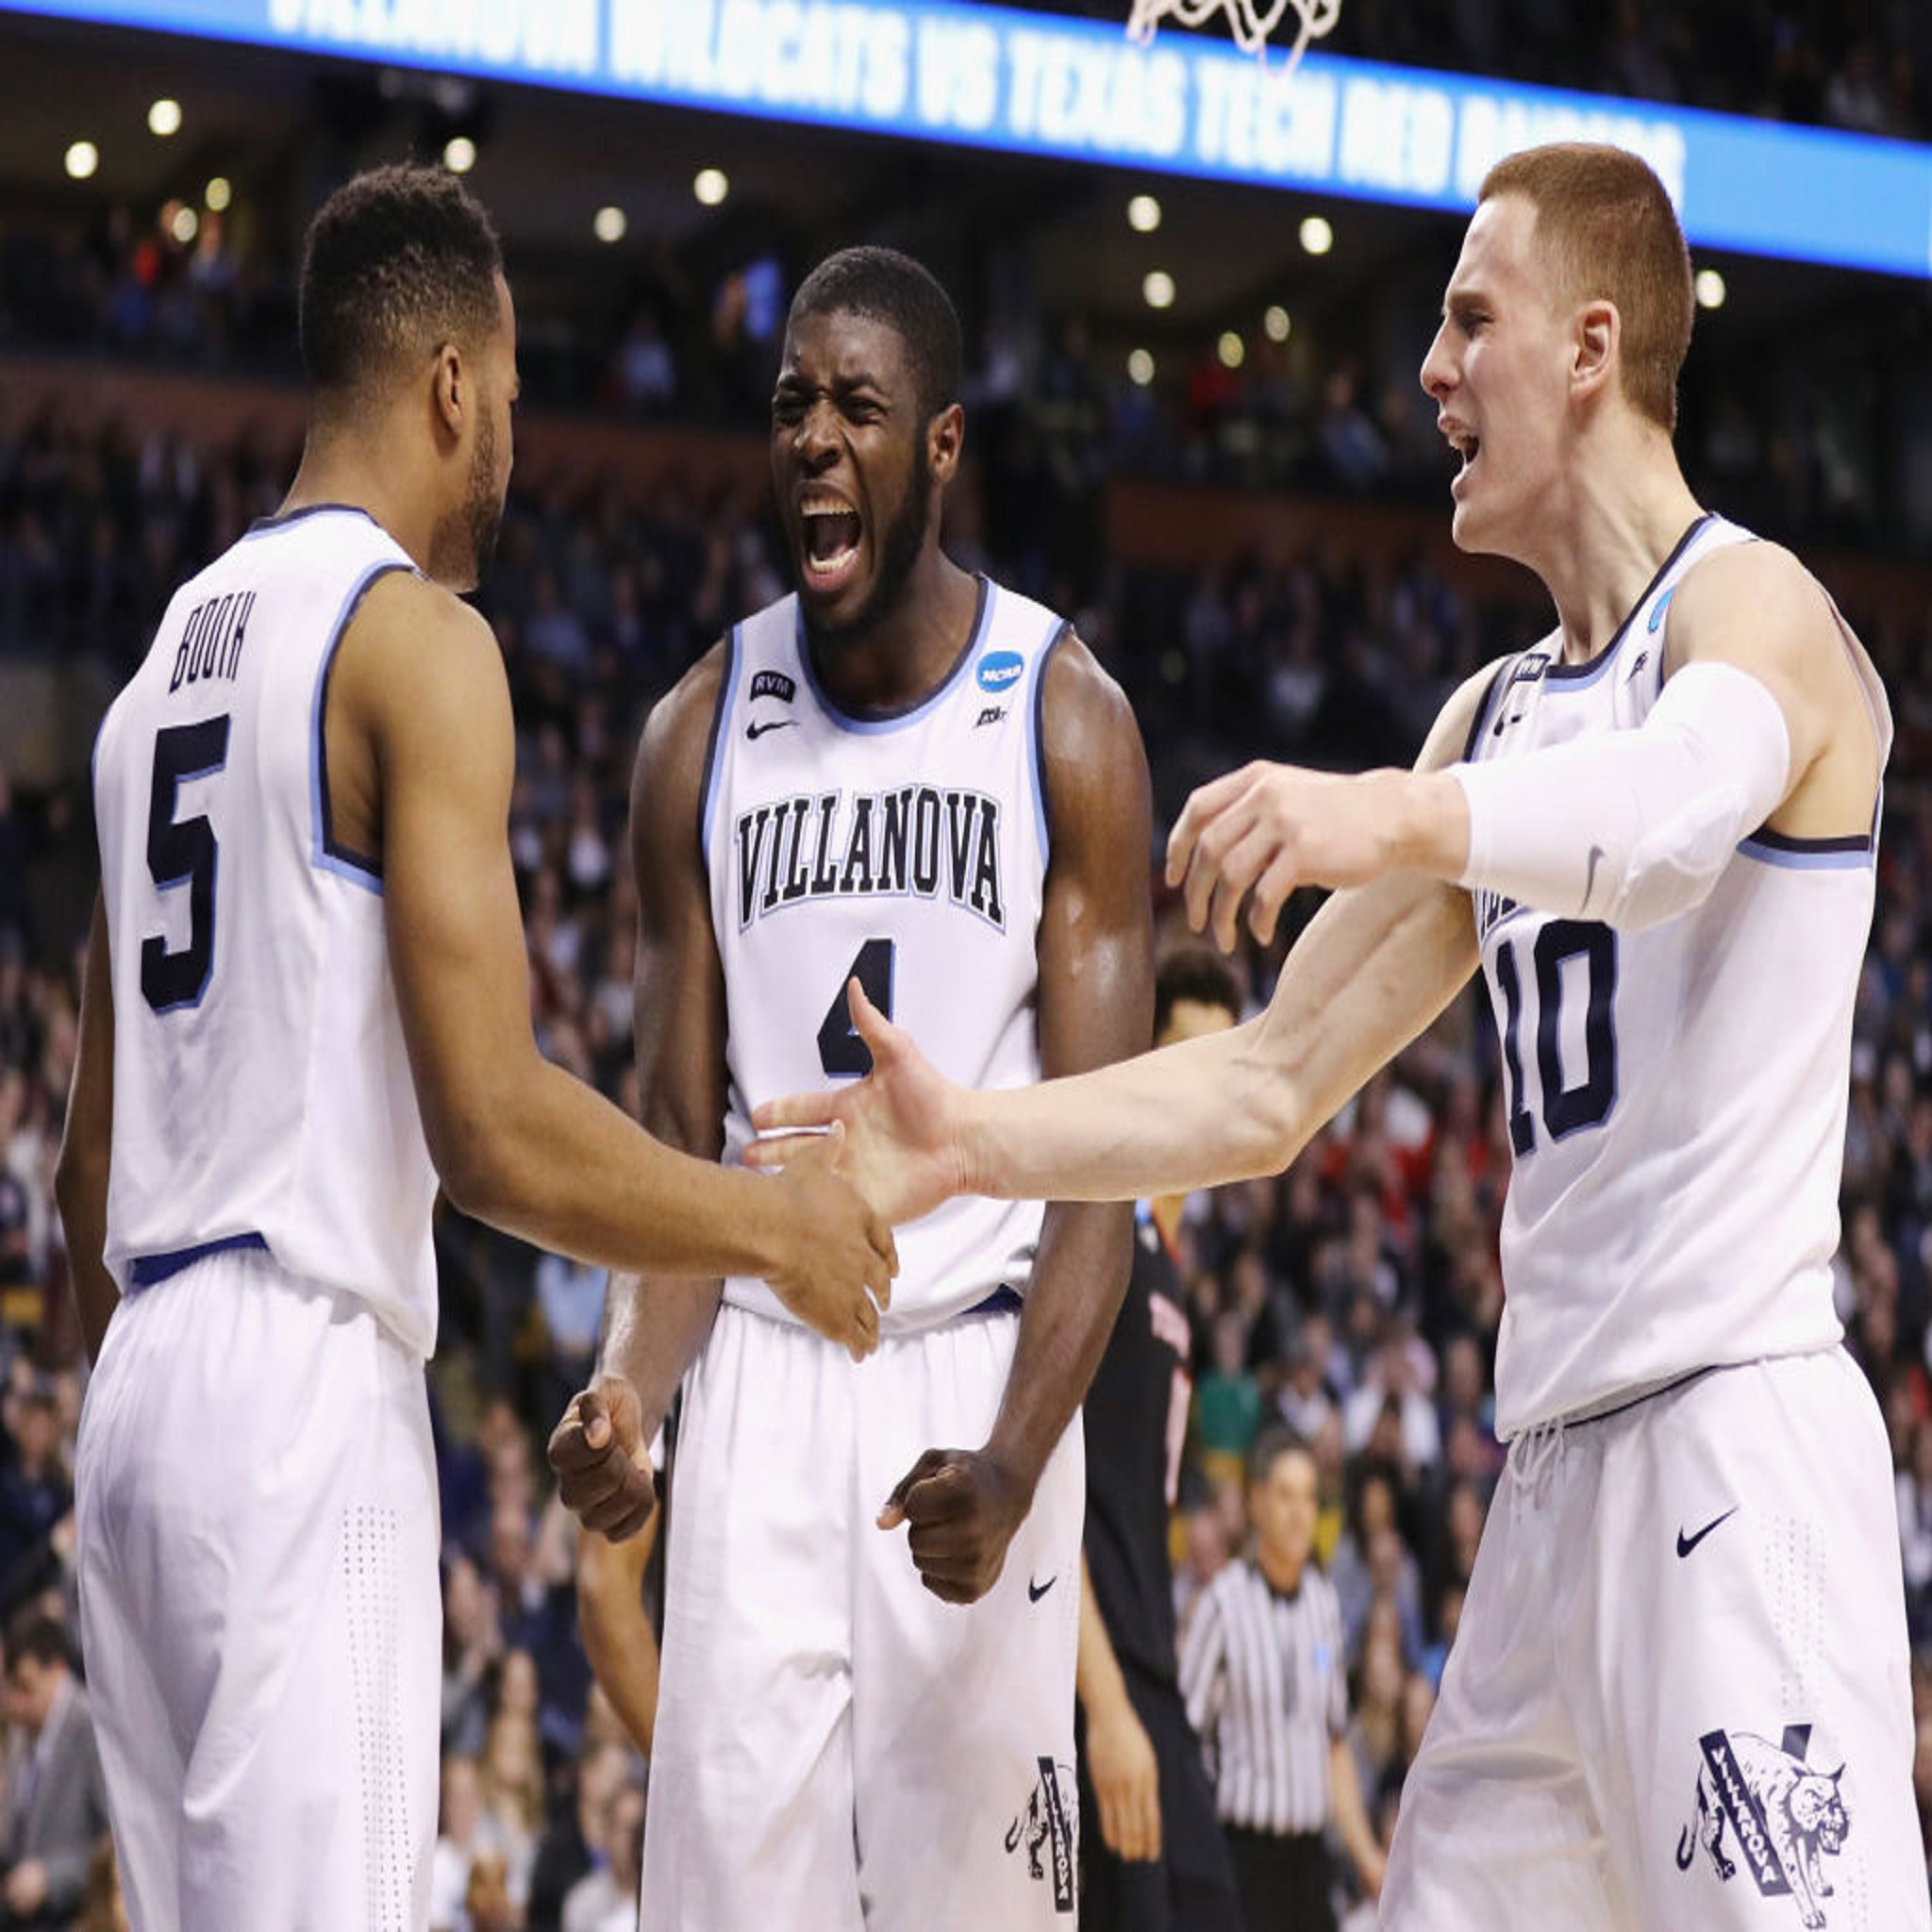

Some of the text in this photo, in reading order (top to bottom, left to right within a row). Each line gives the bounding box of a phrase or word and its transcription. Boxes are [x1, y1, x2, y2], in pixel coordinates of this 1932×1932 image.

[612, 0, 908, 115] WILDCATS
[921, 19, 993, 127] VS
[1010, 31, 1185, 154] TEXAS
[1198, 58, 1336, 175] TECH
[1341, 80, 1453, 191] RED
[169, 591, 257, 695] BOOTH
[755, 674, 791, 694] RVM
[141, 713, 232, 1016] 5
[737, 785, 1006, 934] VILLANOVA
[816, 938, 896, 1079] 4
[1496, 919, 1620, 1158] 10
[1043, 1772, 1070, 1901] VILLANOVA
[1710, 1746, 1777, 1884] VILLANOVA
